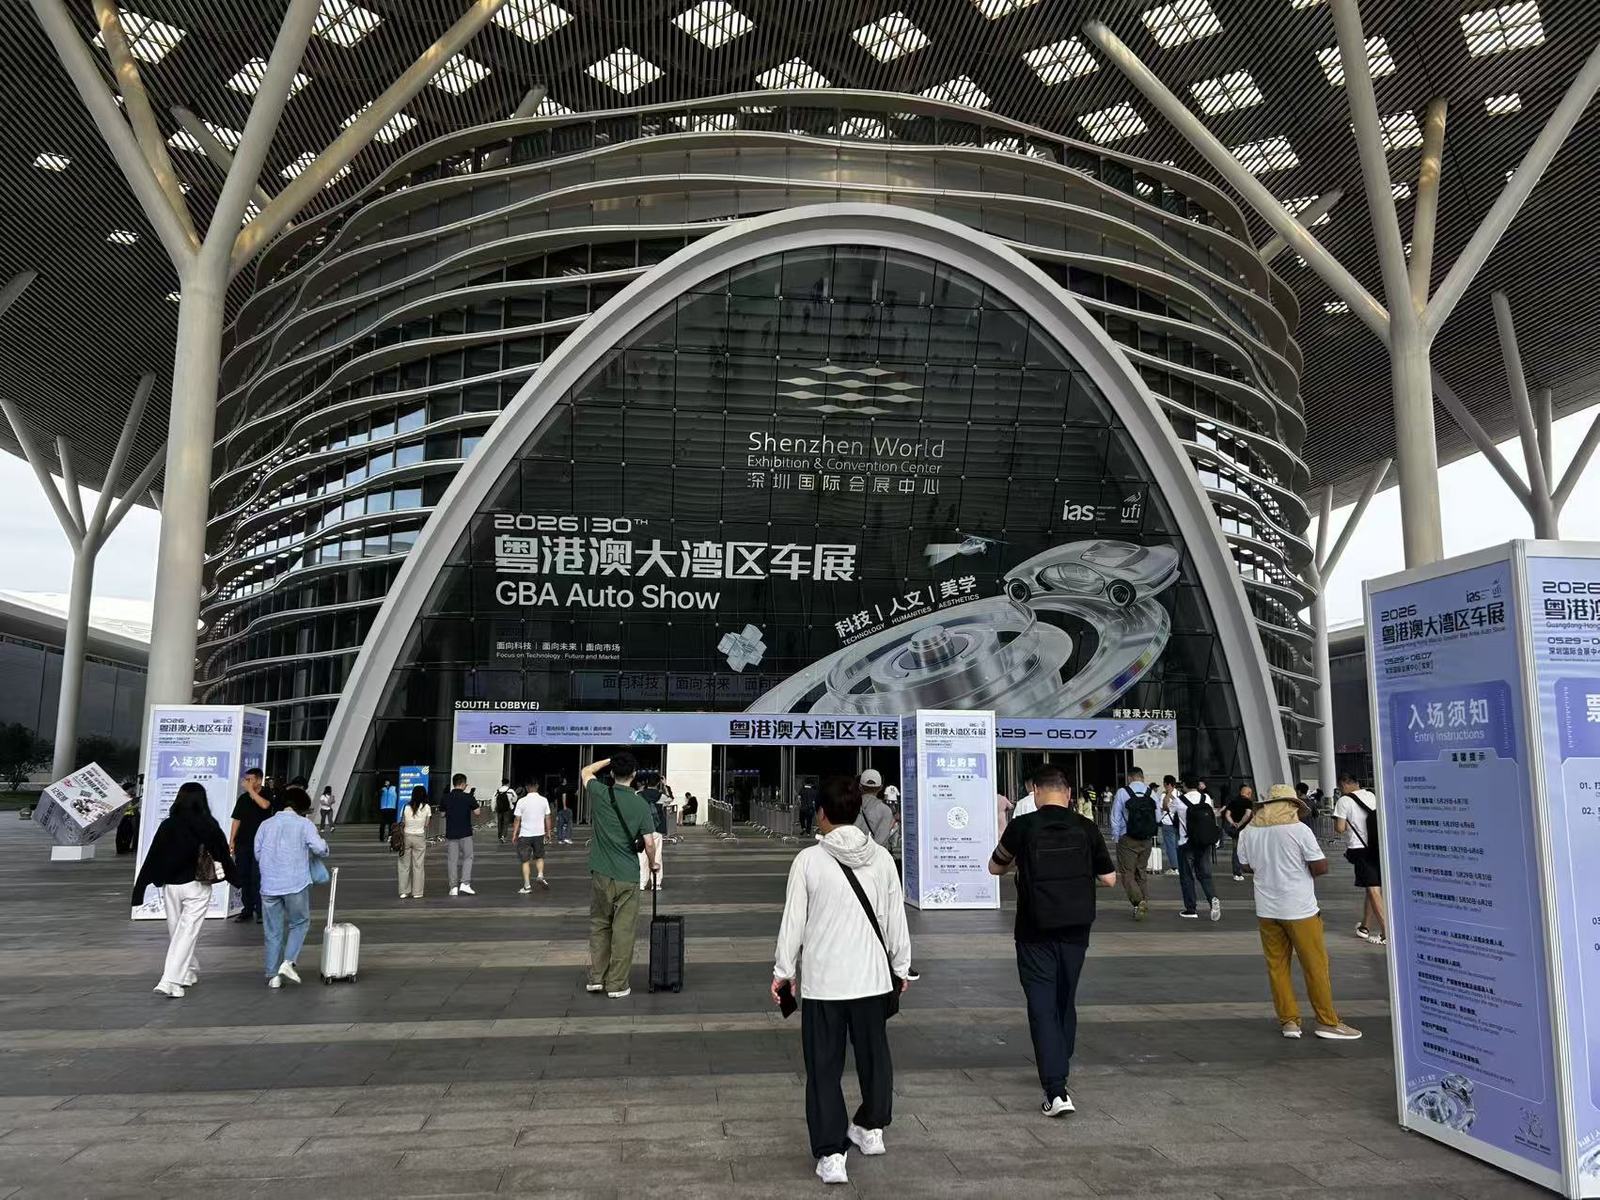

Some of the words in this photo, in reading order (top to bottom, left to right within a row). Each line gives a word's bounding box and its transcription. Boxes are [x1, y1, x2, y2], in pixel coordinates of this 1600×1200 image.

[748, 431, 863, 455] Shenzhen
[873, 436, 945, 458] World
[747, 455, 810, 469] Exhibition
[813, 457, 824, 470] &
[826, 458, 898, 472] Convention
[900, 460, 943, 474] Center
[747, 472, 940, 495] 深圳国际会展中心
[1062, 499, 1095, 521] ias
[1121, 503, 1141, 518] ufi
[494, 513, 579, 532] 2026
[494, 534, 857, 581] 粤港澳大湾区车展
[495, 580, 559, 607] GBA
[565, 582, 634, 608] Auto
[641, 584, 721, 610] Show
[1542, 581, 1600, 595] 2026
[1466, 589, 1481, 604] ias
[834, 609, 873, 638] 科技
[889, 590, 924, 616] 人文
[939, 575, 977, 599] 美学
[1381, 604, 1417, 622] 2026
[842, 622, 886, 646] TECHNOLOGY
[891, 605, 932, 624] HUMANITIES
[938, 593, 980, 609] AESTHETICS
[1382, 601, 1505, 645] 粤港澳大湾区车展
[496, 641, 532, 650] 面向科技
[542, 642, 577, 651] 面向未来
[526, 652, 561, 660] Technology
[454, 700, 490, 709] SOUTH
[494, 700, 540, 710] LOBBY(E)
[1112, 708, 1177, 719] 南登录大厅(东)
[1407, 698, 1489, 730] 入场须知
[489, 721, 509, 735] ias
[729, 719, 899, 741] 粤港澳大湾区车展
[1047, 729, 1098, 740] 06.07
[1415, 731, 1435, 744] Entry
[1436, 729, 1485, 742] Instructions
[169, 756, 218, 767] 入场须知
[1579, 782, 1592, 790] 01.
[1581, 807, 1595, 815] 02.
